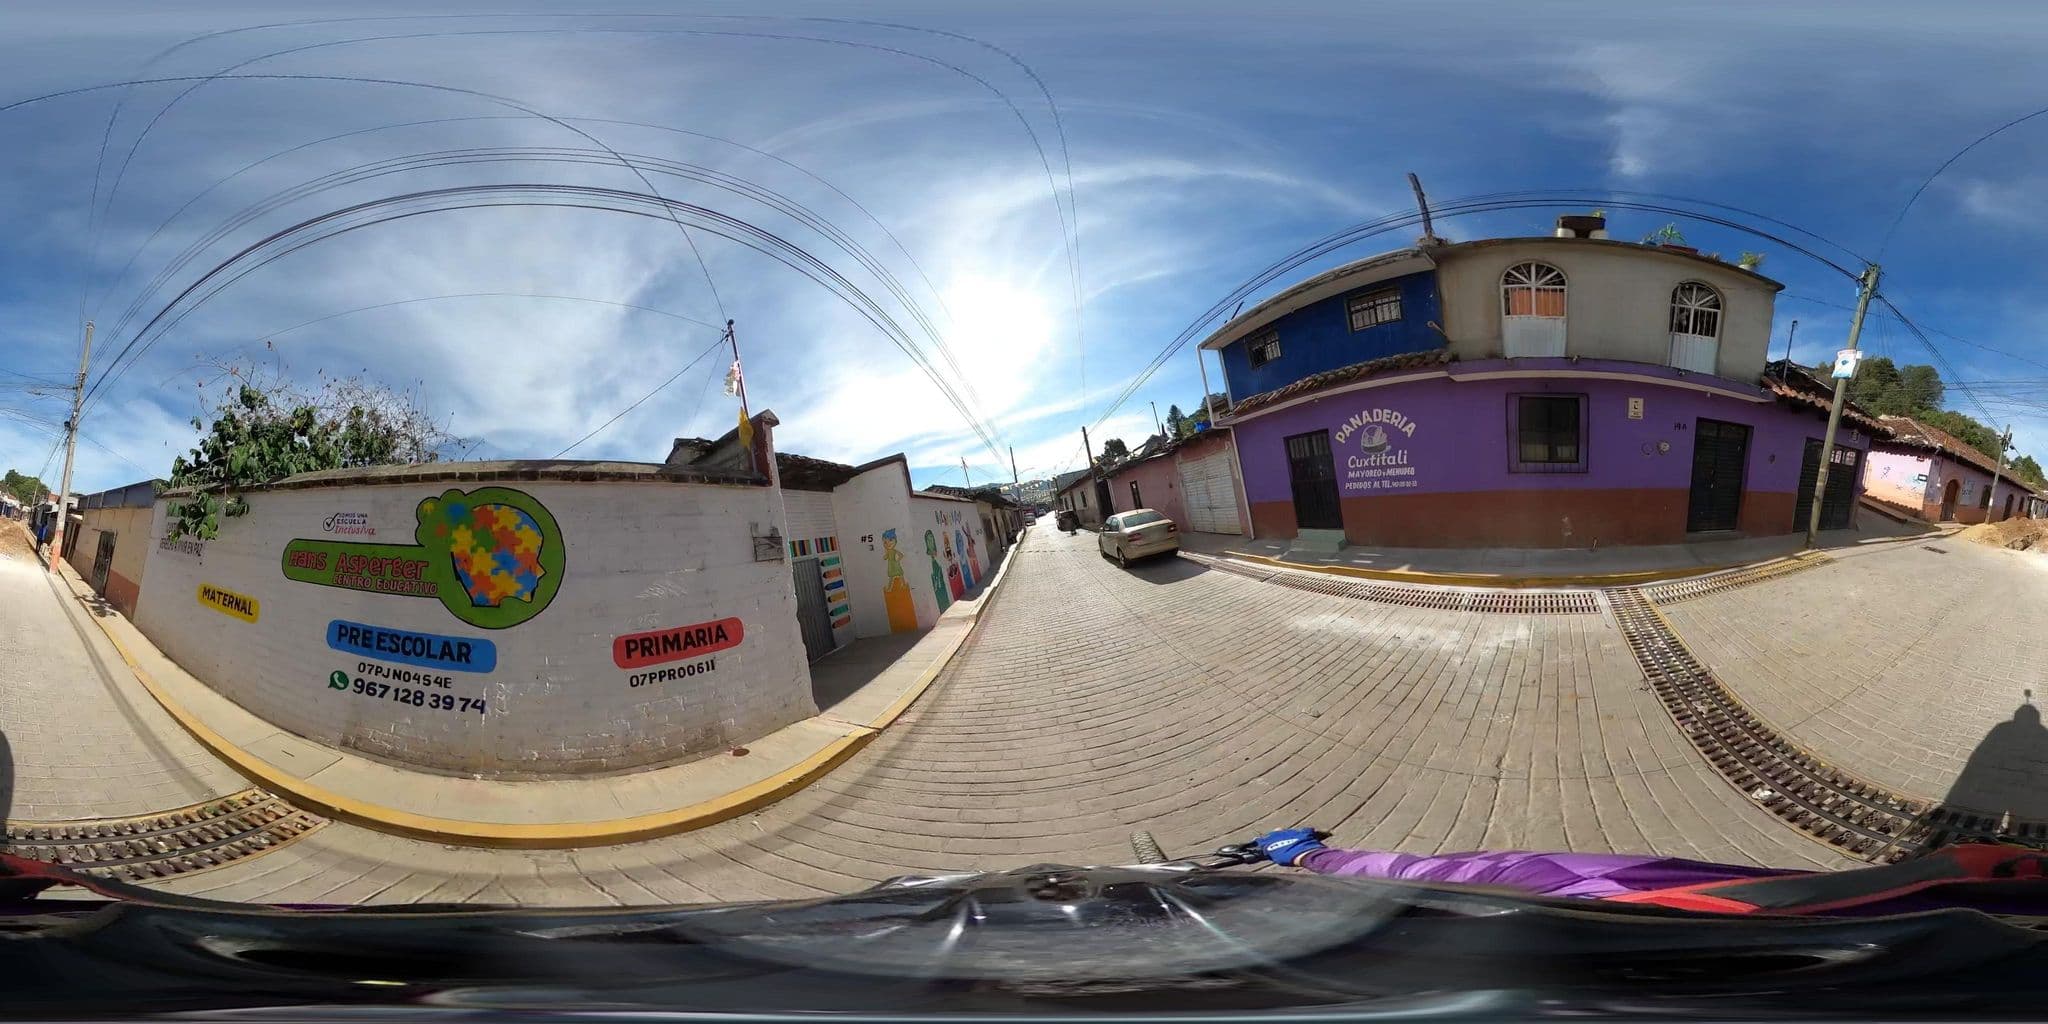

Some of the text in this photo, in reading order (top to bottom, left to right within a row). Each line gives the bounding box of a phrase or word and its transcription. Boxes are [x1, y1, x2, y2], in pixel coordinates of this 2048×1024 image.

[1335, 408, 1416, 444] PANADERIA
[1347, 449, 1408, 468] Cuxtitali
[1345, 481, 1371, 490] PEDIDOS
[1372, 481, 1381, 489] AL
[1348, 469, 1382, 478] MAYOREO
[1386, 467, 1415, 476] MENUDEO
[333, 573, 438, 594] CENTRO EDUCATIVO
[202, 586, 253, 617] MATERNAL
[625, 624, 729, 660] PRIMARIA
[352, 677, 487, 715] 967 128 39 74
